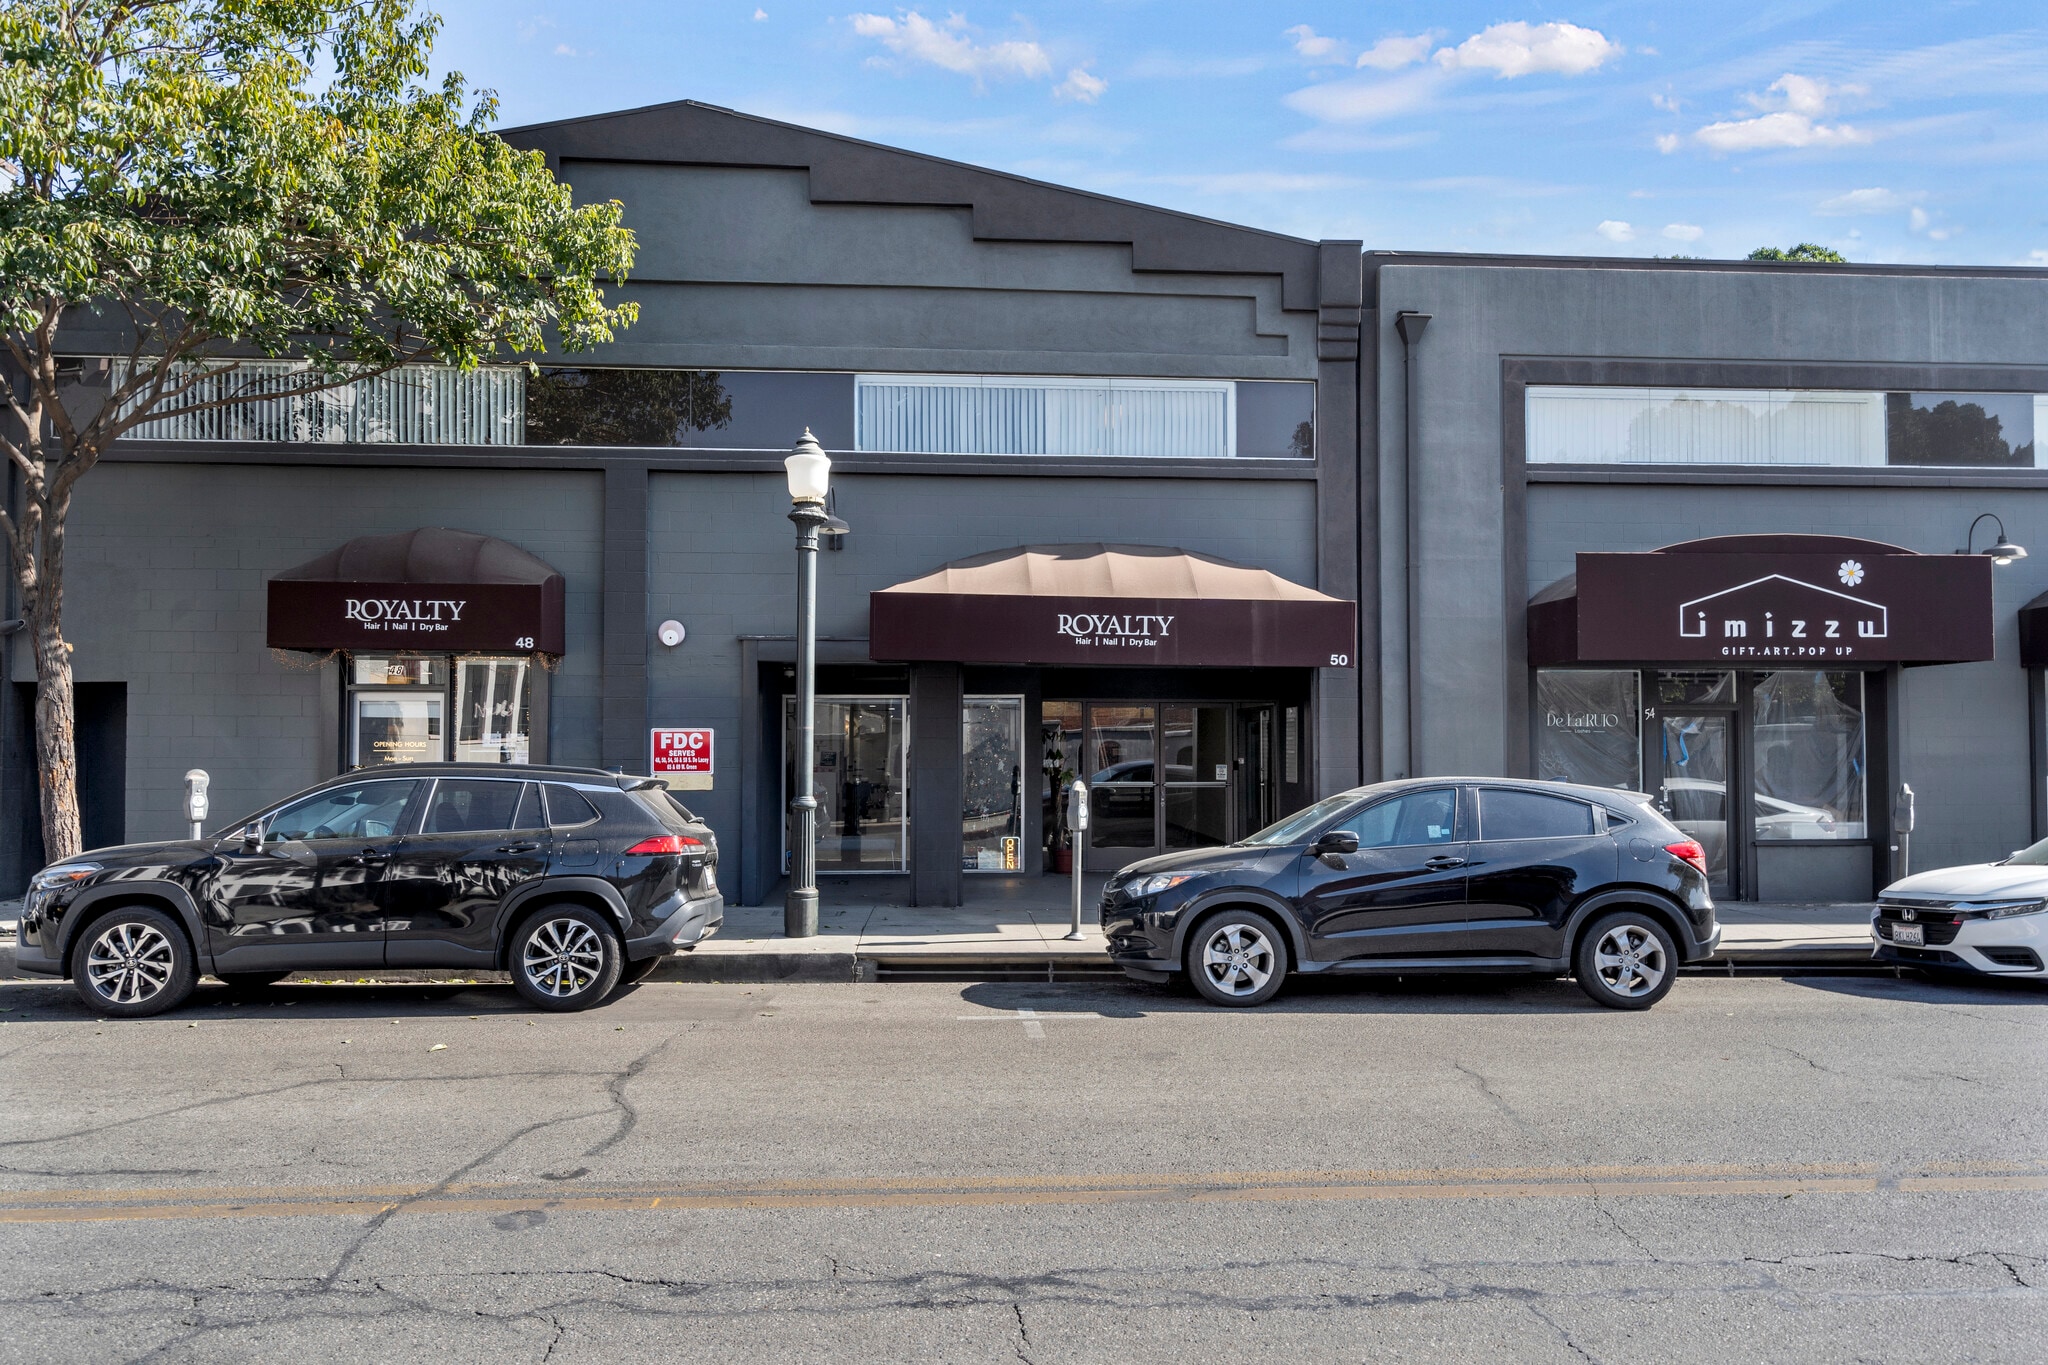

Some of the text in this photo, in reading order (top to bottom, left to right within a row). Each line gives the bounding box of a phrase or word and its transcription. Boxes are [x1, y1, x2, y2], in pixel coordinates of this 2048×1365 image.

[345, 600, 466, 621] ROYALTY
[419, 623, 434, 632] Dry
[435, 623, 448, 631] Bar
[1057, 614, 1174, 636] ROYALTY
[1698, 611, 1874, 638] imizzu
[515, 637, 534, 648] 48
[1075, 637, 1091, 645] Hair
[1129, 638, 1143, 647] Dry
[1144, 638, 1157, 646] Bar
[1835, 647, 1853, 656] UP
[1330, 654, 1348, 666] 50
[388, 665, 403, 675] 48
[1644, 707, 1656, 720] 54
[660, 732, 704, 749] FDC
[1006, 838, 1014, 870] OPEN
